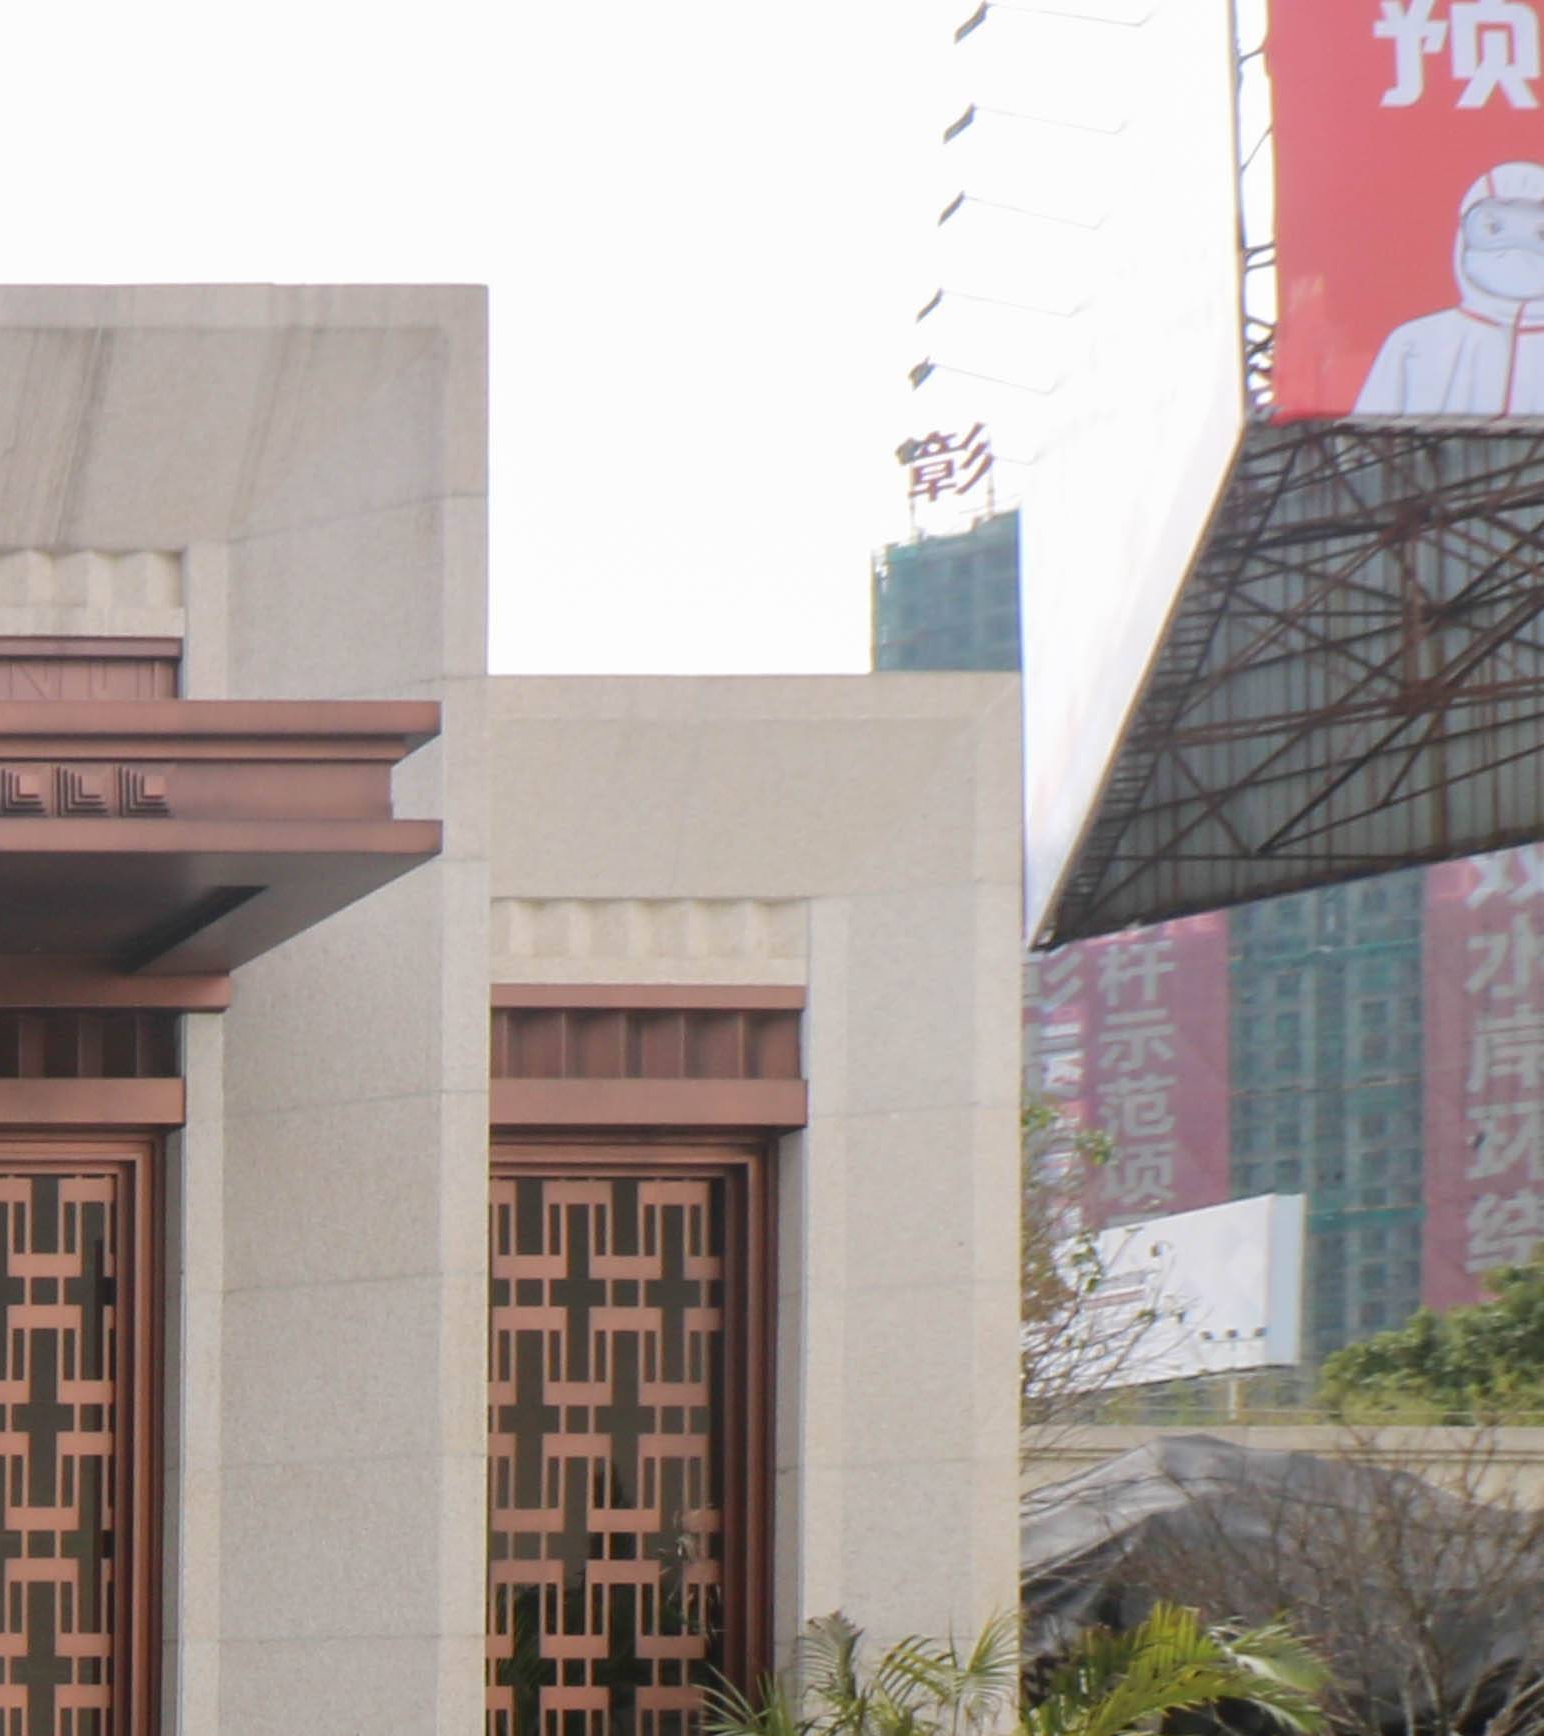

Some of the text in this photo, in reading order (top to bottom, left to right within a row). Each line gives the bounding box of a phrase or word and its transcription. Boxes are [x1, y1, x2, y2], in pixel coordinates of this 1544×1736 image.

[1372, 0, 1542, 109] 预
[906, 421, 994, 502] 彰
[1097, 938, 1178, 1224] 杆示范项
